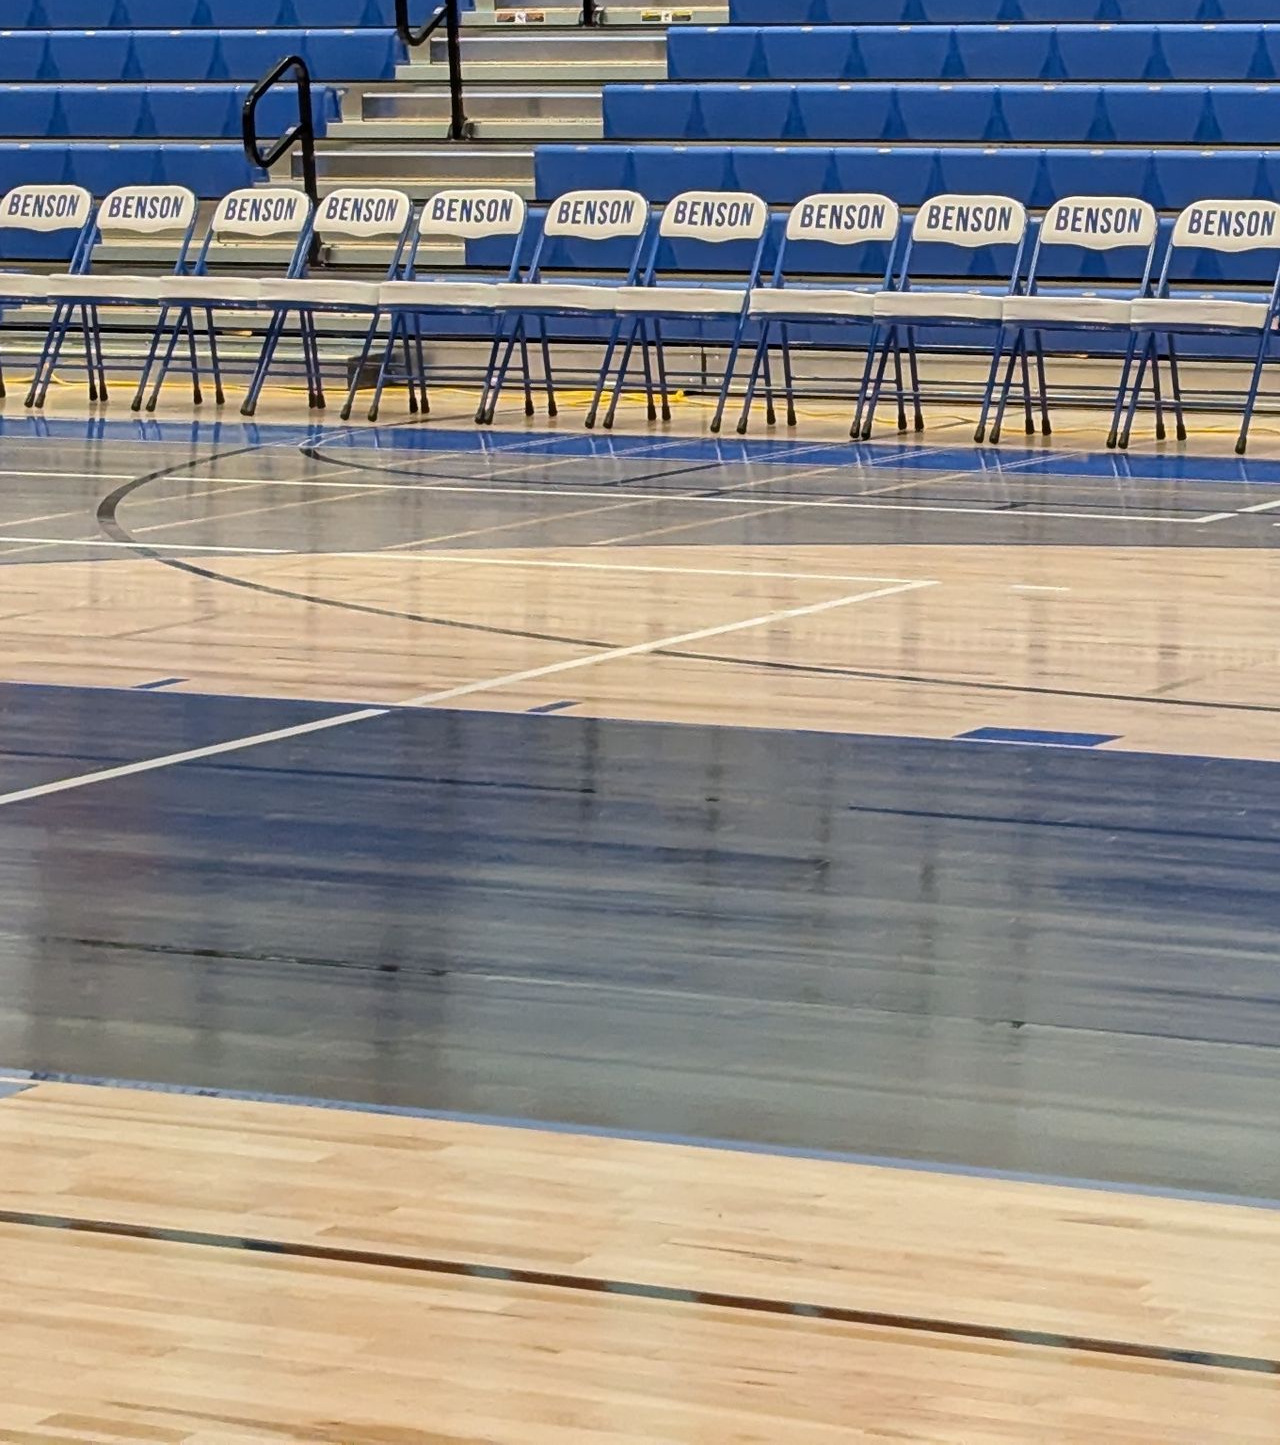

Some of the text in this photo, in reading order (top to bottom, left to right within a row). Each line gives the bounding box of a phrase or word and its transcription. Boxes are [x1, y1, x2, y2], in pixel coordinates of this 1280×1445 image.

[7, 192, 79, 219] BENSON
[107, 194, 184, 221] BENSON
[223, 196, 297, 222] BENSON
[325, 196, 400, 222] BENSON
[431, 197, 513, 225] BENSON
[557, 199, 634, 226] BENSON
[673, 201, 755, 228] BENSON
[800, 203, 886, 230] BENSON
[926, 204, 1012, 232] BENSON
[1054, 206, 1142, 235] BENSON
[1188, 209, 1275, 238] BENSON
